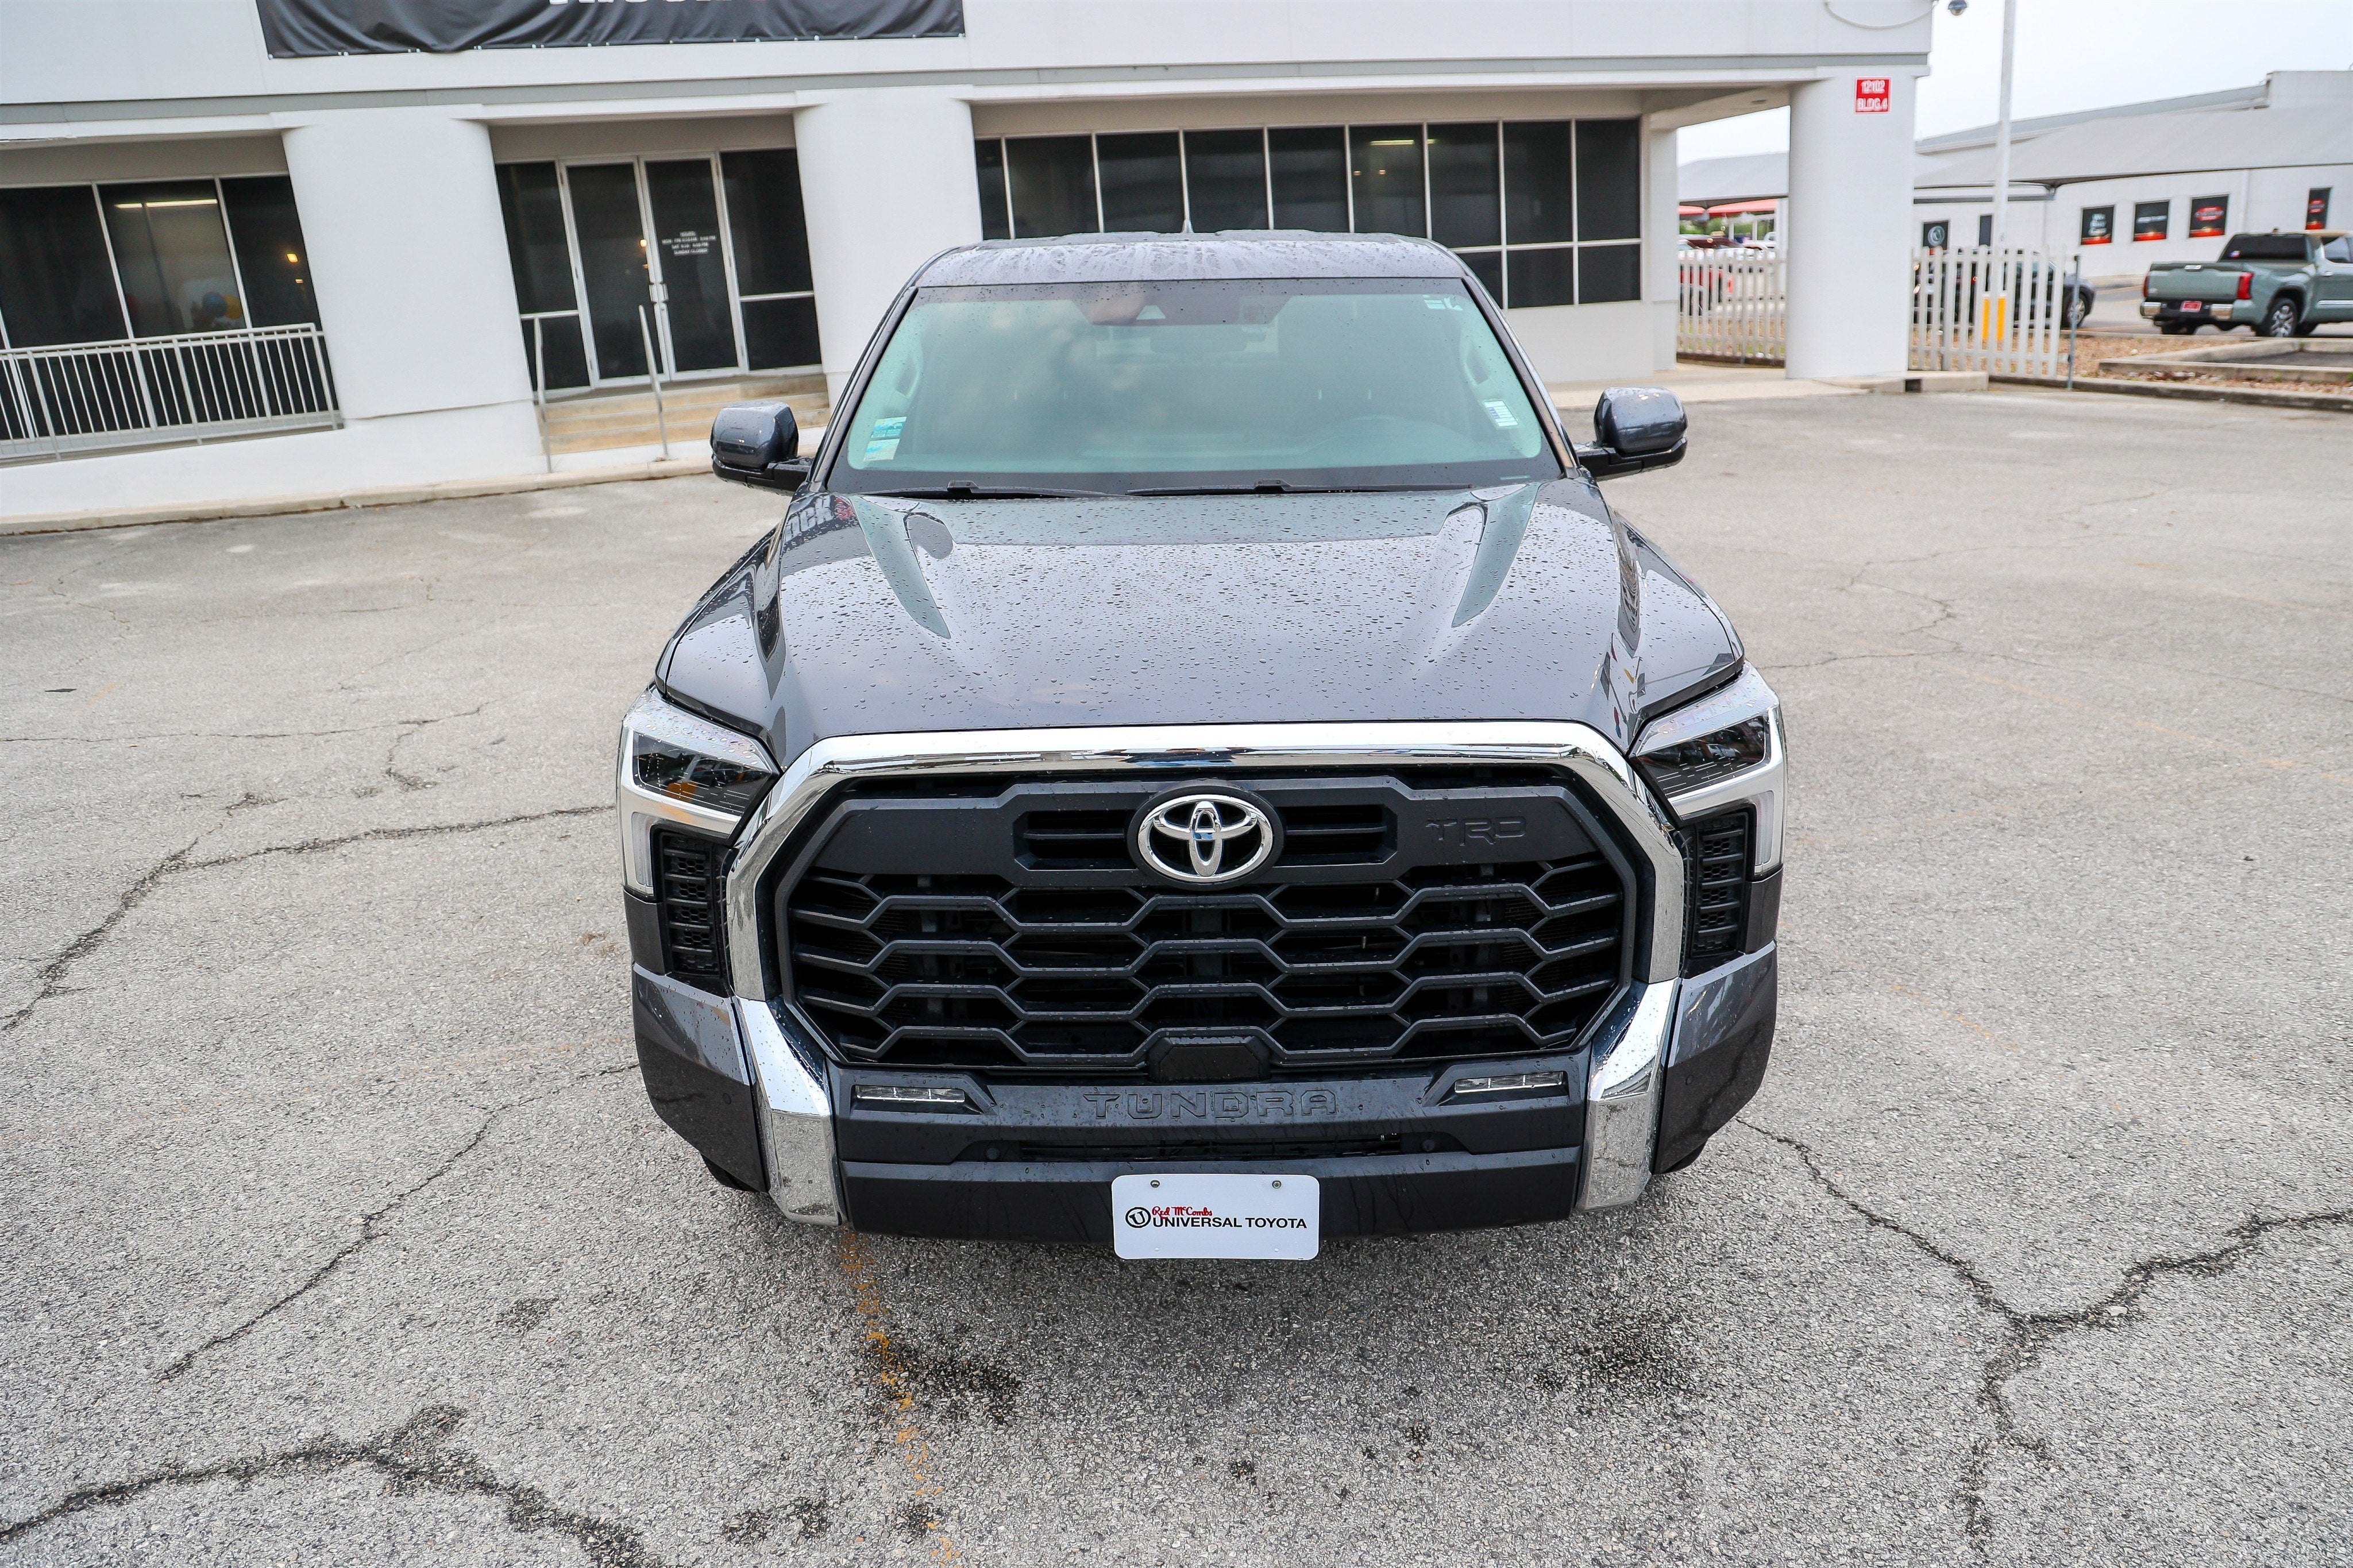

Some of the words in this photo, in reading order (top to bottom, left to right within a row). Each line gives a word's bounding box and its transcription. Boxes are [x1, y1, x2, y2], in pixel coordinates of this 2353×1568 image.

[1425, 816, 1526, 846] TRD
[1082, 1090, 1337, 1119] TUNDRA
[1152, 1206, 1170, 1219] Red
[1171, 1206, 1213, 1216] McCombs
[1153, 1217, 1242, 1227] UNIVERSAL
[1245, 1218, 1307, 1228] TOYOTA
